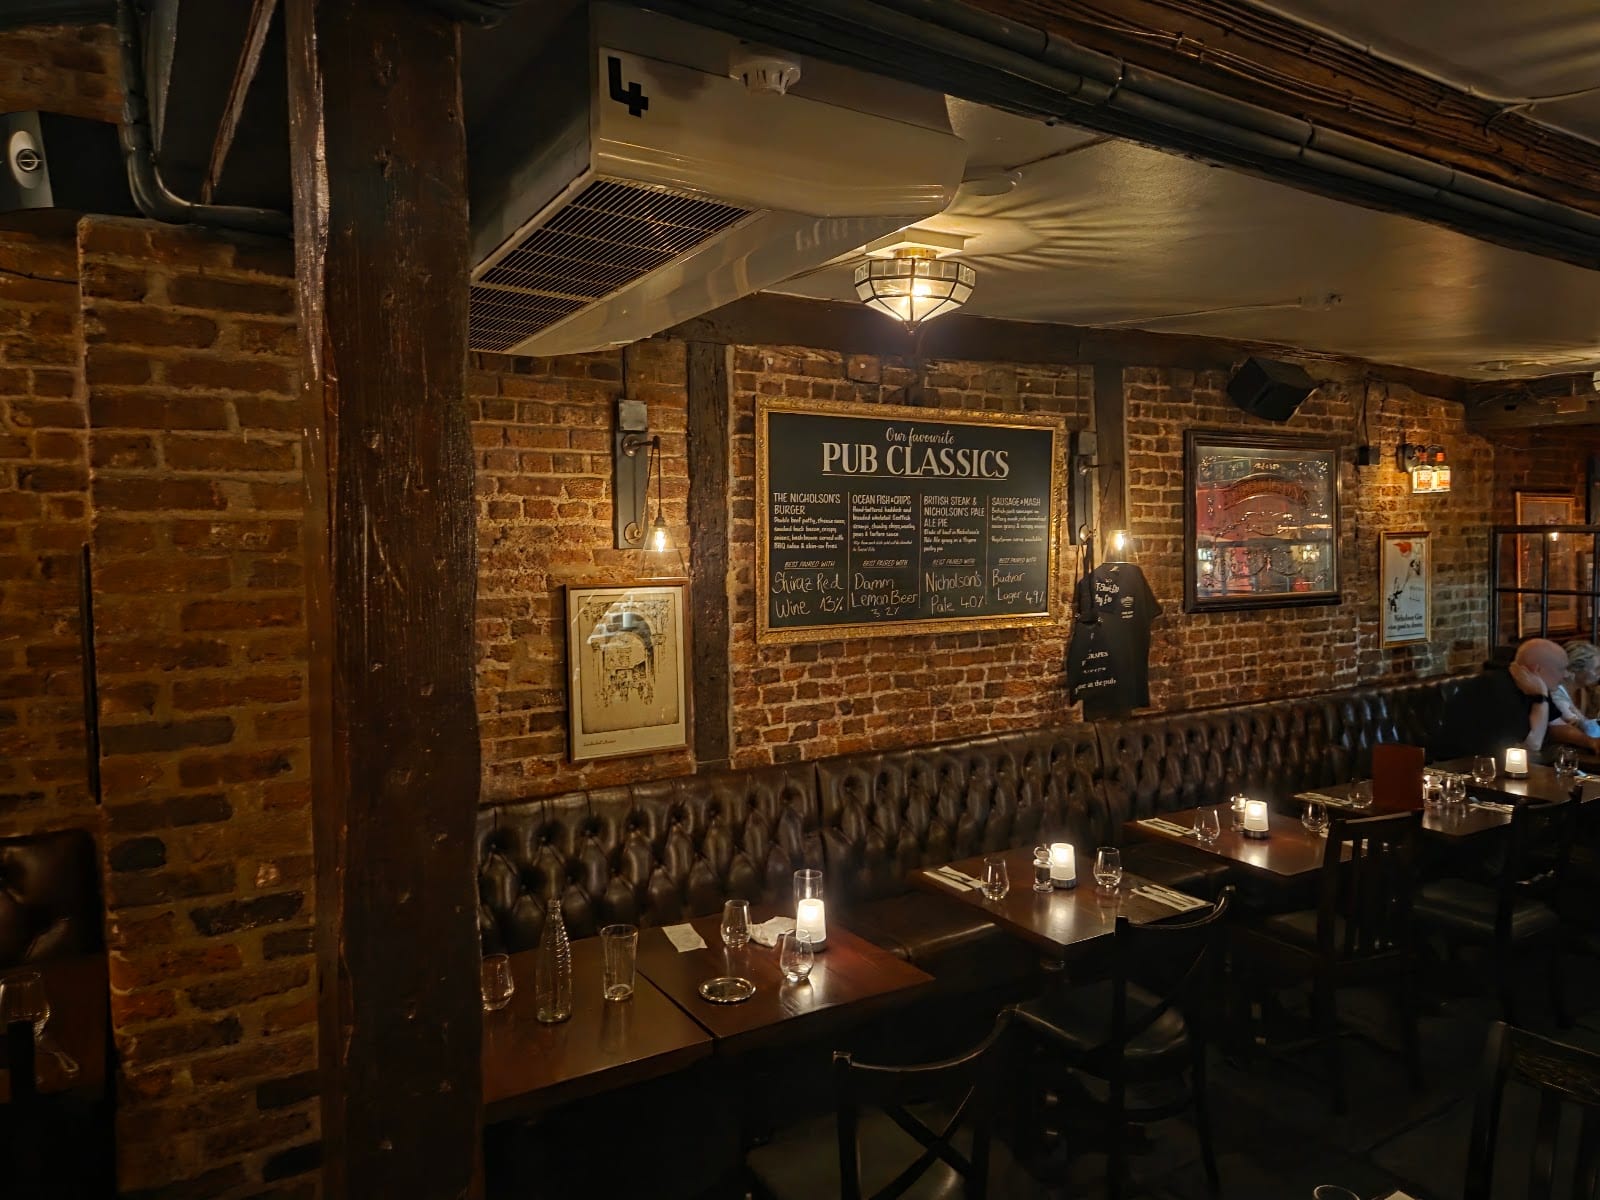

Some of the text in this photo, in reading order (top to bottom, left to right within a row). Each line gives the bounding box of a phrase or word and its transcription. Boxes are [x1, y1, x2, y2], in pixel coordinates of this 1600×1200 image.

[608, 56, 648, 117] 4
[885, 427, 955, 446] Our favourite
[821, 442, 1010, 478] PUB CLASSICS
[773, 492, 841, 504] THE NICHOLSON'S
[852, 494, 876, 505] OCEAN
[923, 495, 977, 506] BRITISH STEAK &
[774, 504, 806, 515] BURGER
[923, 506, 985, 517] NICHOLSON'S PALE
[923, 518, 948, 528] ALE PIE
[820, 560, 836, 568] WITH
[771, 571, 845, 594] Shiraz Red
[854, 572, 895, 590] Damm
[925, 570, 982, 593] Nicholson's
[851, 589, 919, 608] Lemon Beer
[931, 593, 955, 616] Pale
[997, 587, 1023, 604] Lager
[775, 598, 811, 619] Wine
